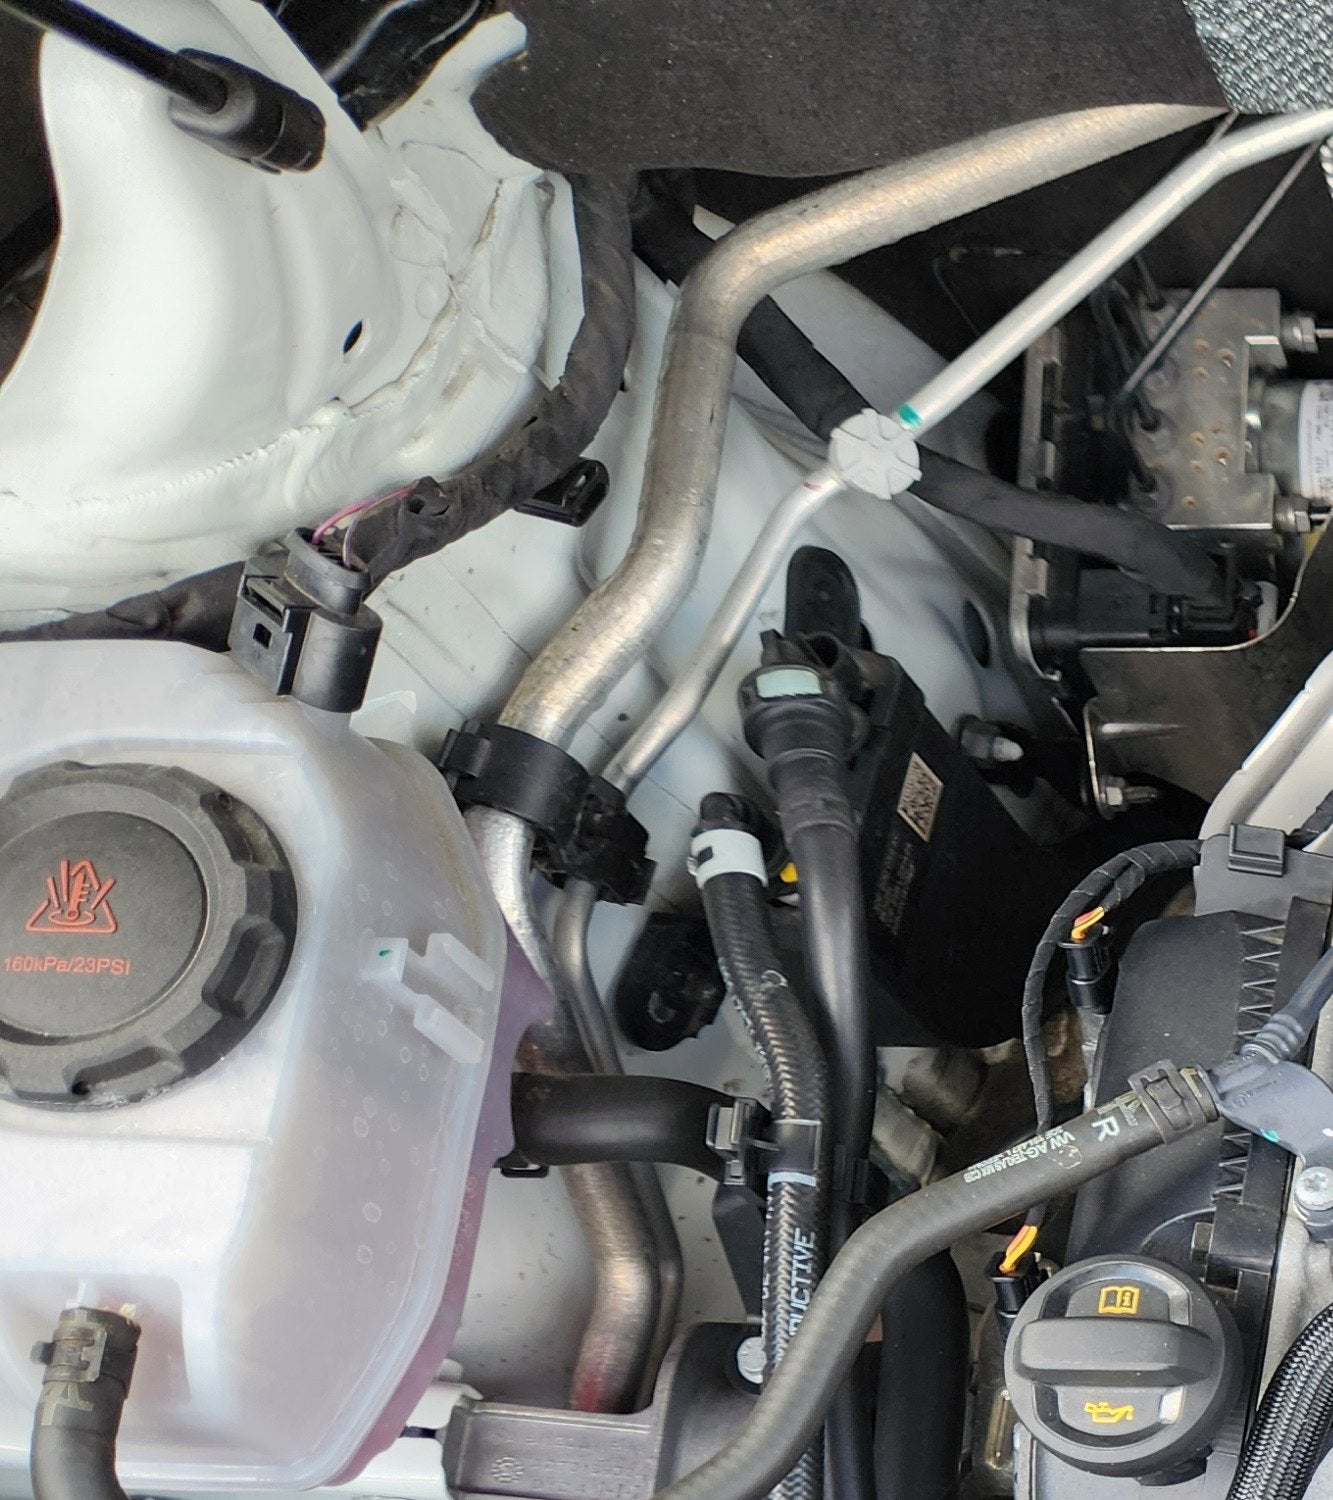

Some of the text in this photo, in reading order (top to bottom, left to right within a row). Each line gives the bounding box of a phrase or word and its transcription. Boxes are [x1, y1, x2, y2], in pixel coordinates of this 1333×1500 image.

[4, 956, 131, 976] 160kPa/23PSI
[1091, 1115, 1120, 1142] R
[1049, 1130, 1076, 1150] VW
[1025, 1142, 1049, 1159] AG
